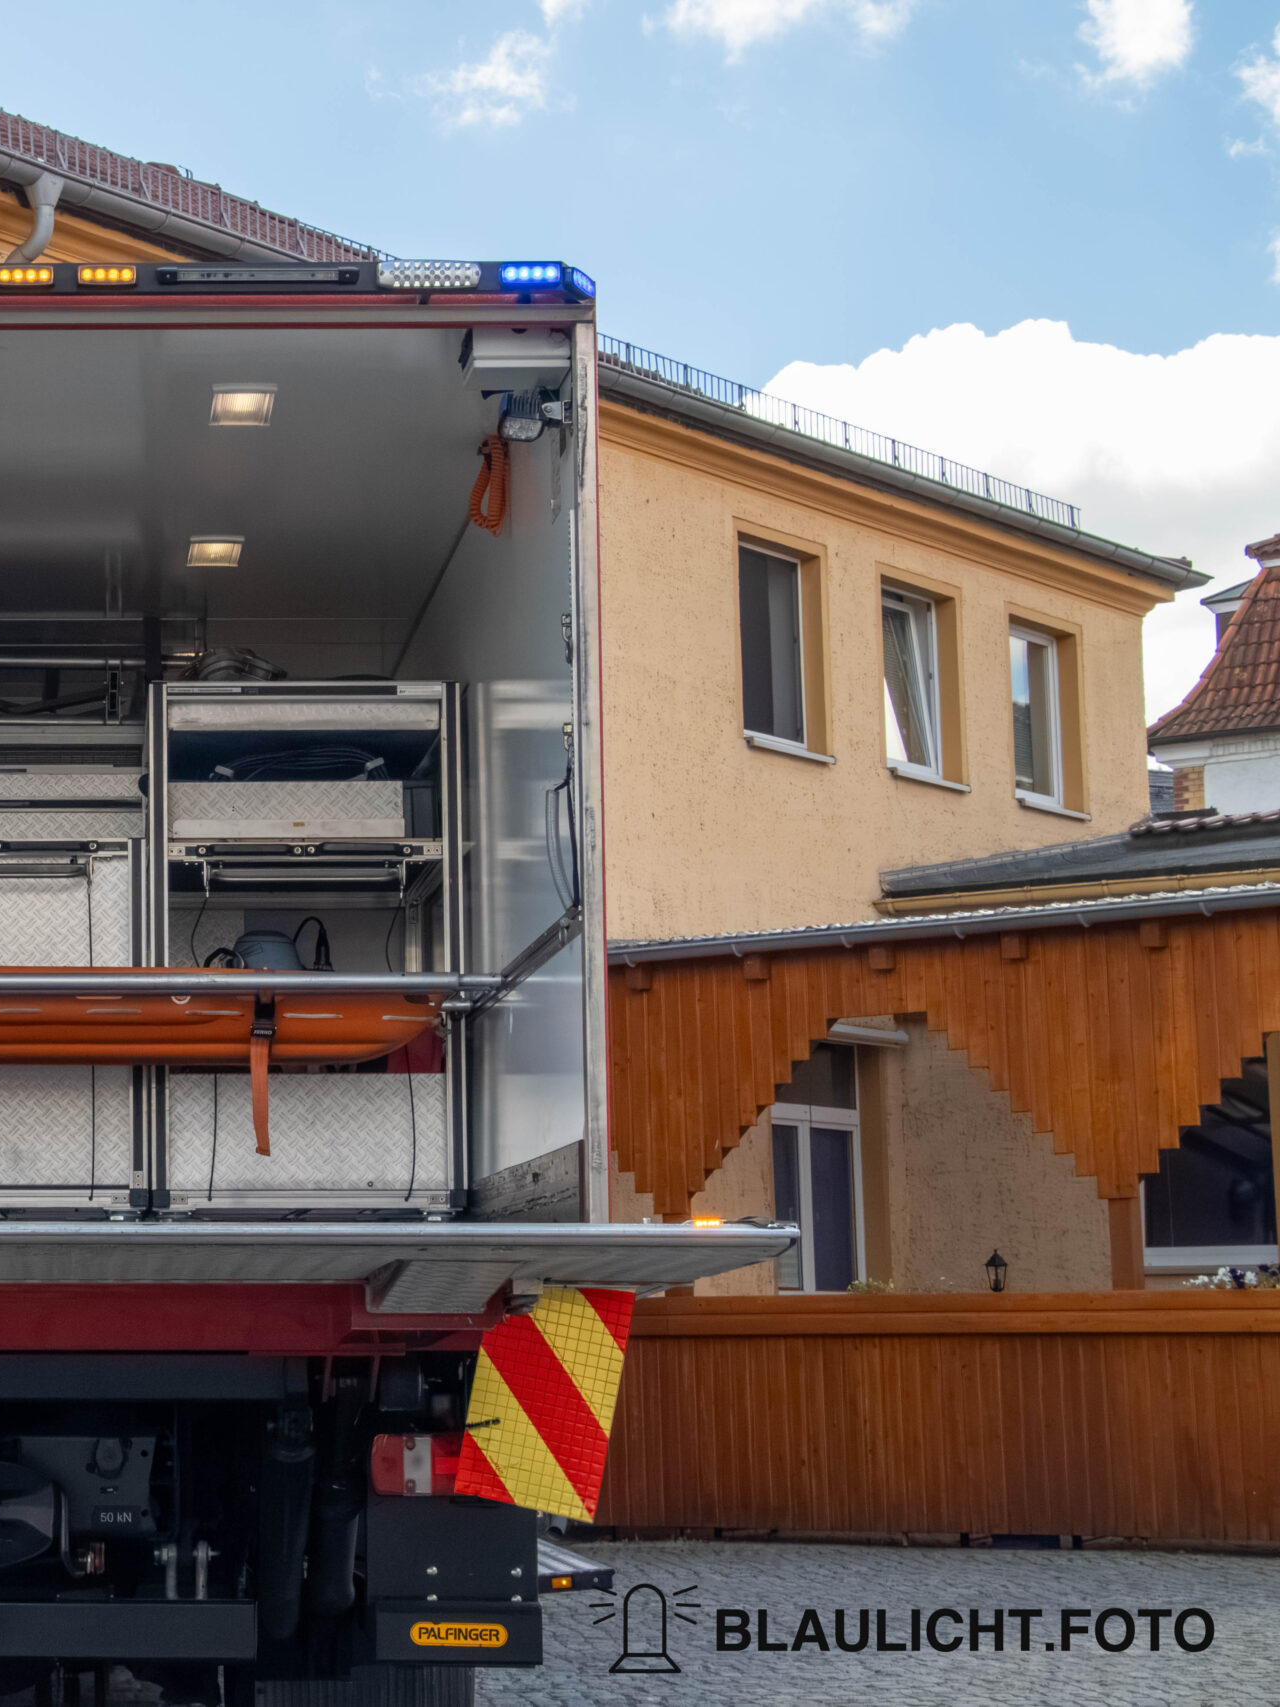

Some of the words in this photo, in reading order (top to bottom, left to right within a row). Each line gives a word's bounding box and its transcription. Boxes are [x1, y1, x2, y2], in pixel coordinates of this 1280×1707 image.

[101, 1512, 114, 1523] 50
[117, 1512, 132, 1523] kN
[418, 1626, 500, 1642] PALFINGER
